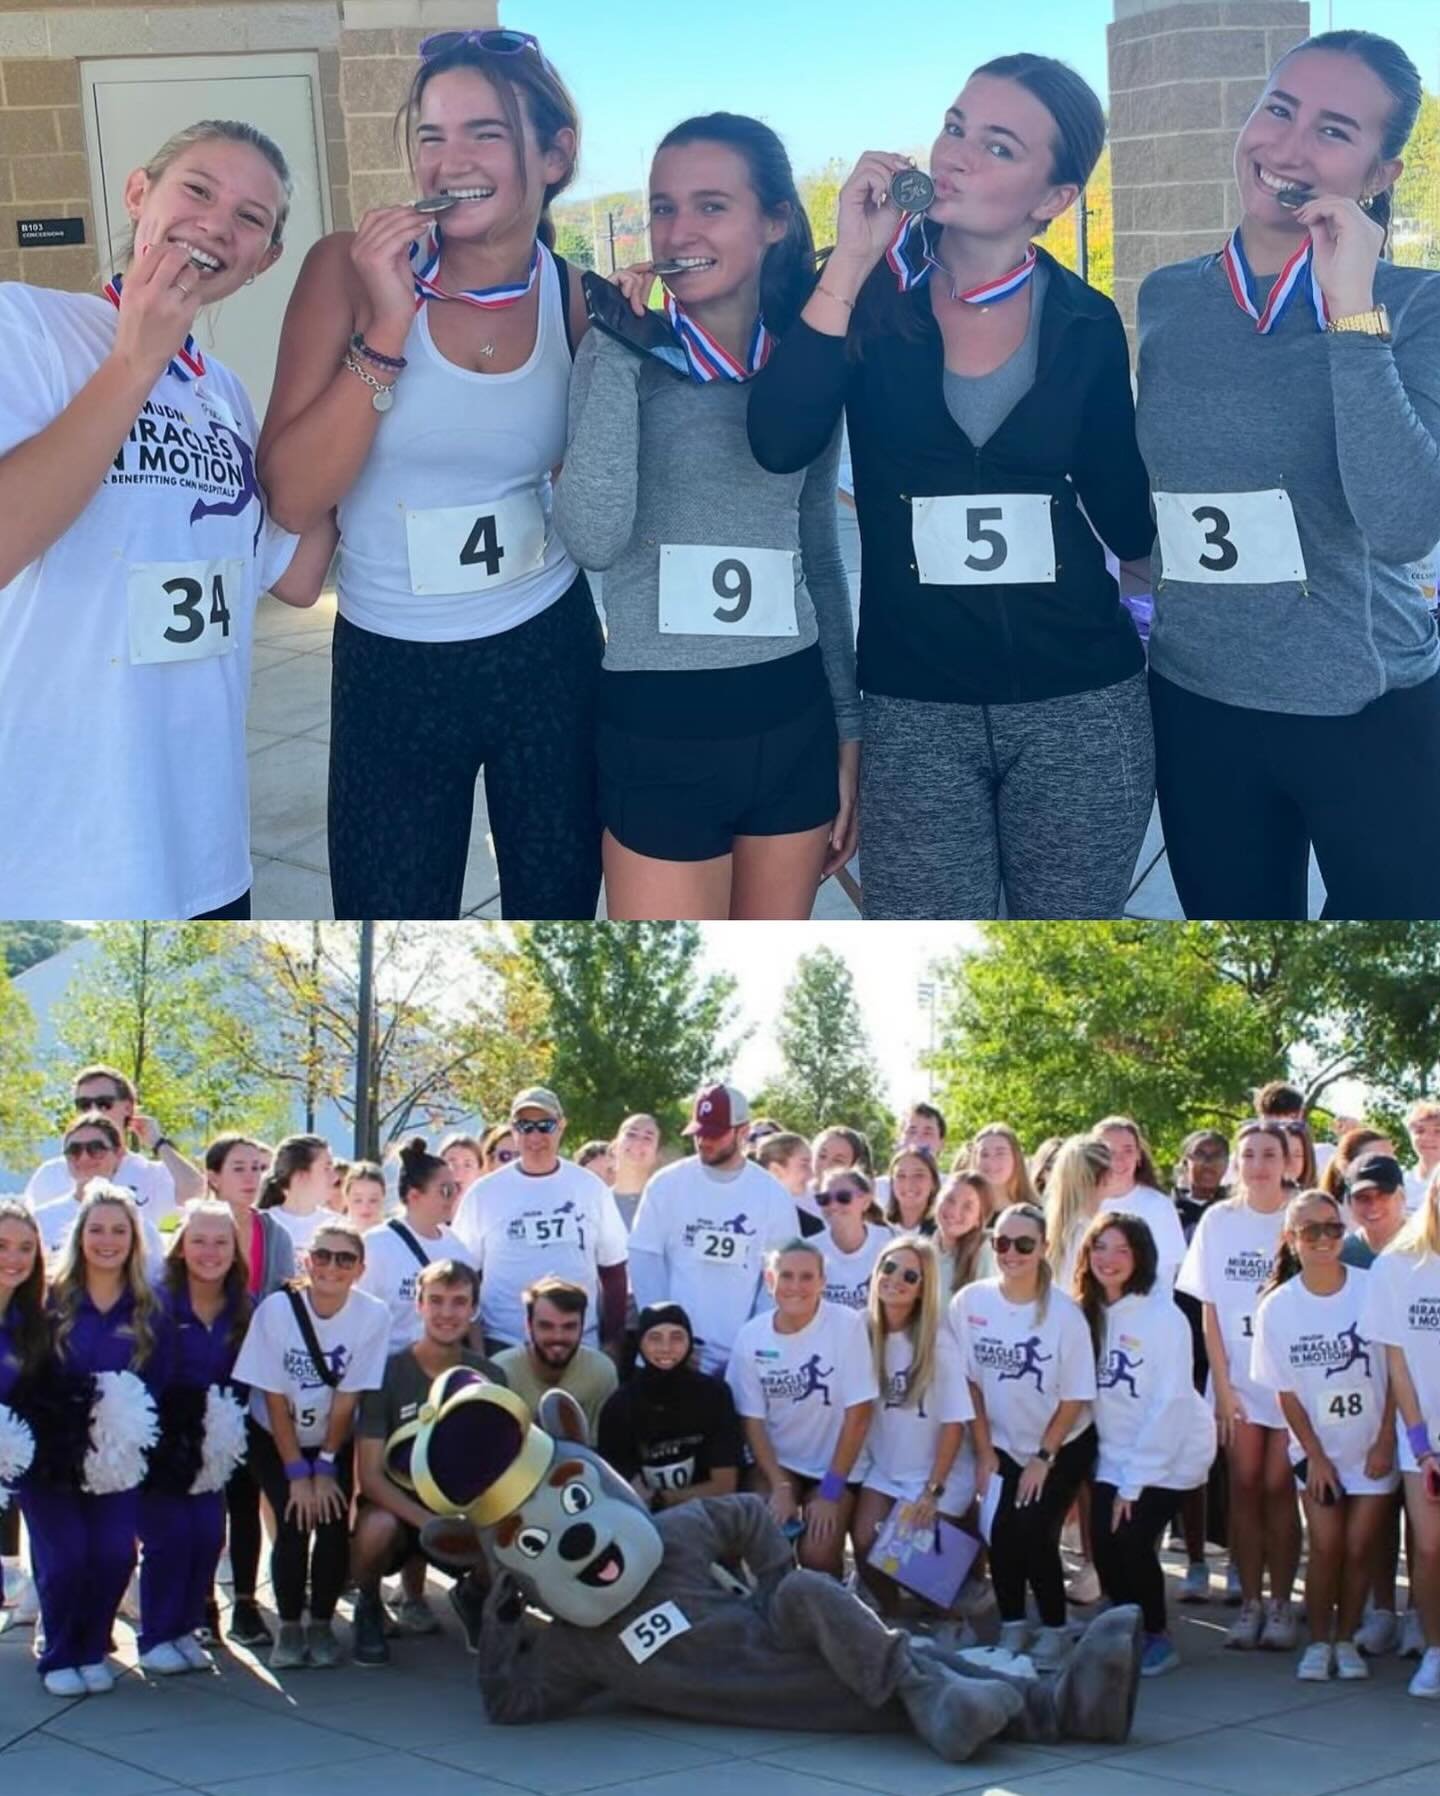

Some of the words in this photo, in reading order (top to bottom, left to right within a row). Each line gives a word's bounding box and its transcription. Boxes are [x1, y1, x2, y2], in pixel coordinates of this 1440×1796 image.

[21, 223, 43, 232] B103
[129, 418, 233, 460] IRACLES
[139, 444, 243, 488] MOTION
[111, 474, 177, 486] BENEFITTING
[198, 483, 235, 498] HOSPITALS
[459, 514, 504, 577] 4
[963, 507, 1008, 572] 5
[1191, 505, 1238, 572] 3
[712, 558, 752, 623] 9
[161, 573, 231, 645] 34
[535, 1218, 564, 1240] 57
[704, 1235, 735, 1259] 29
[301, 1408, 316, 1428] 5
[1329, 1393, 1363, 1418] 48
[655, 1467, 687, 1489] 10
[634, 1613, 672, 1648] 59
